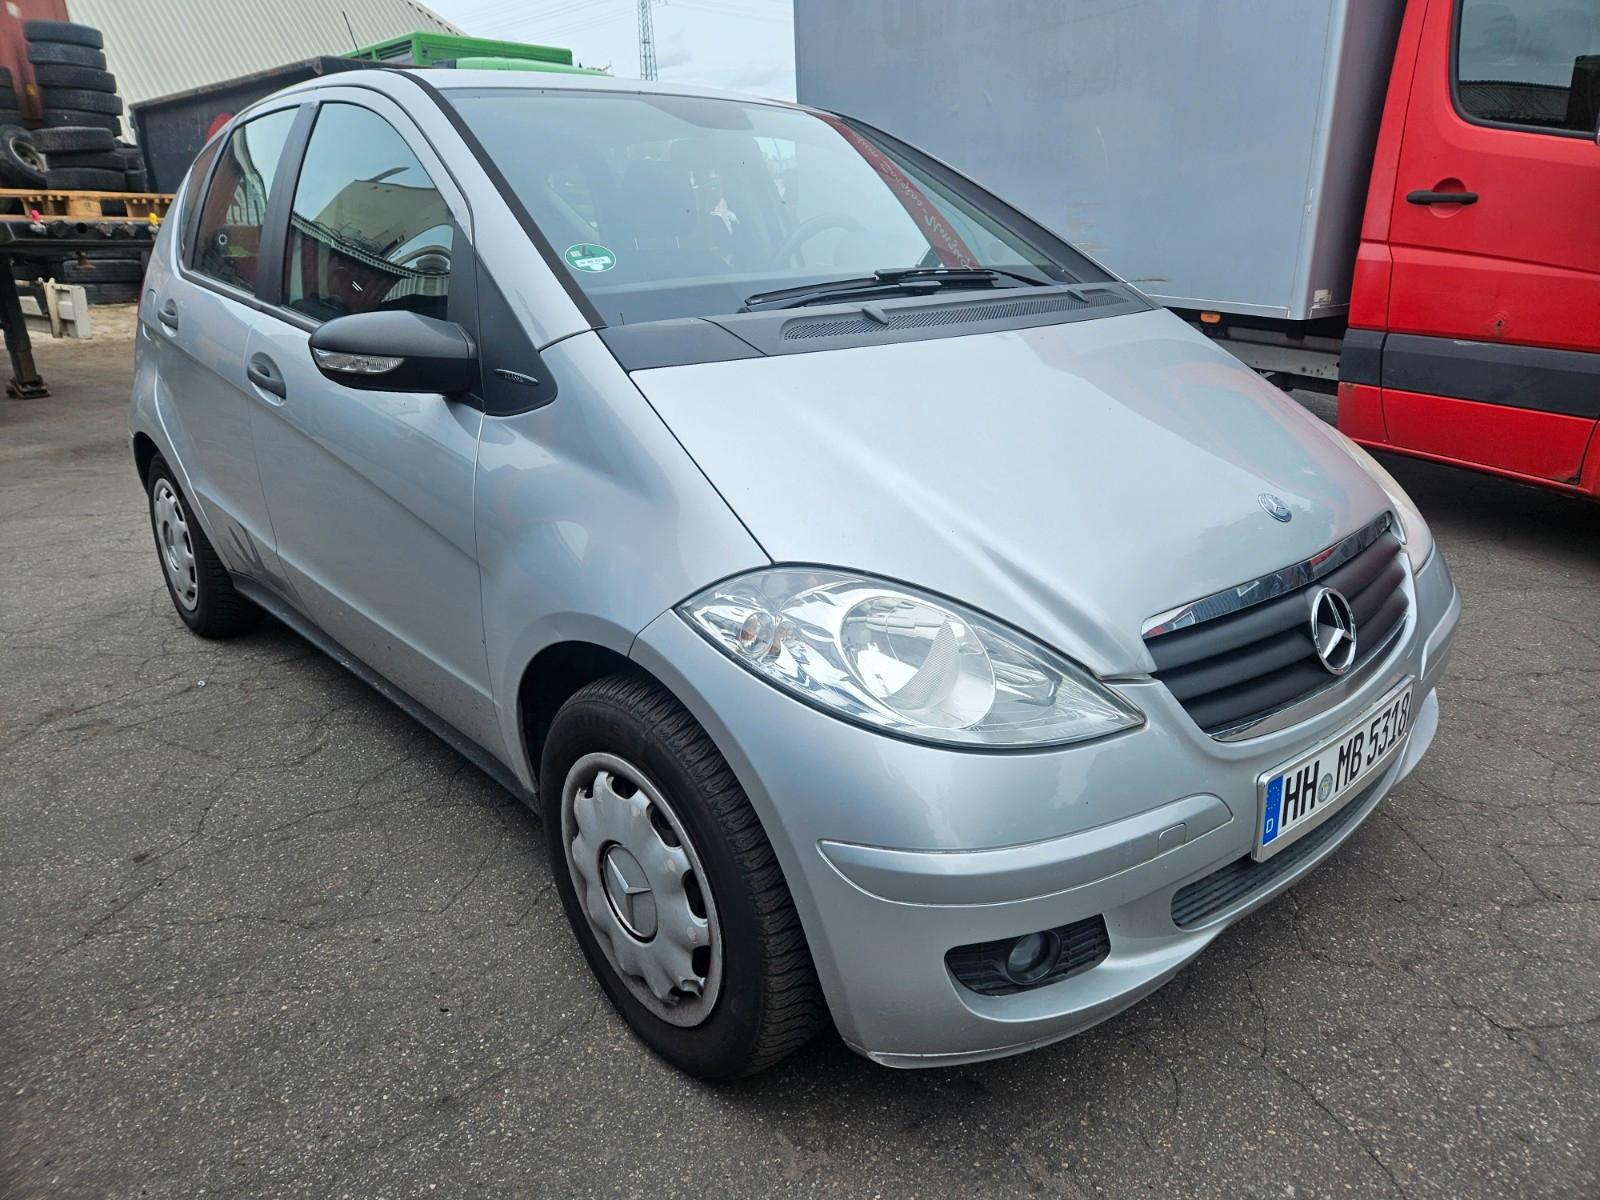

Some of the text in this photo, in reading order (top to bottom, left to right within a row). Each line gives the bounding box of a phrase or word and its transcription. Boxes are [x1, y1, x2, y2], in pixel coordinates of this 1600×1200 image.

[1281, 692, 1410, 828] HH MB 5318
[1265, 818, 1275, 834] D
